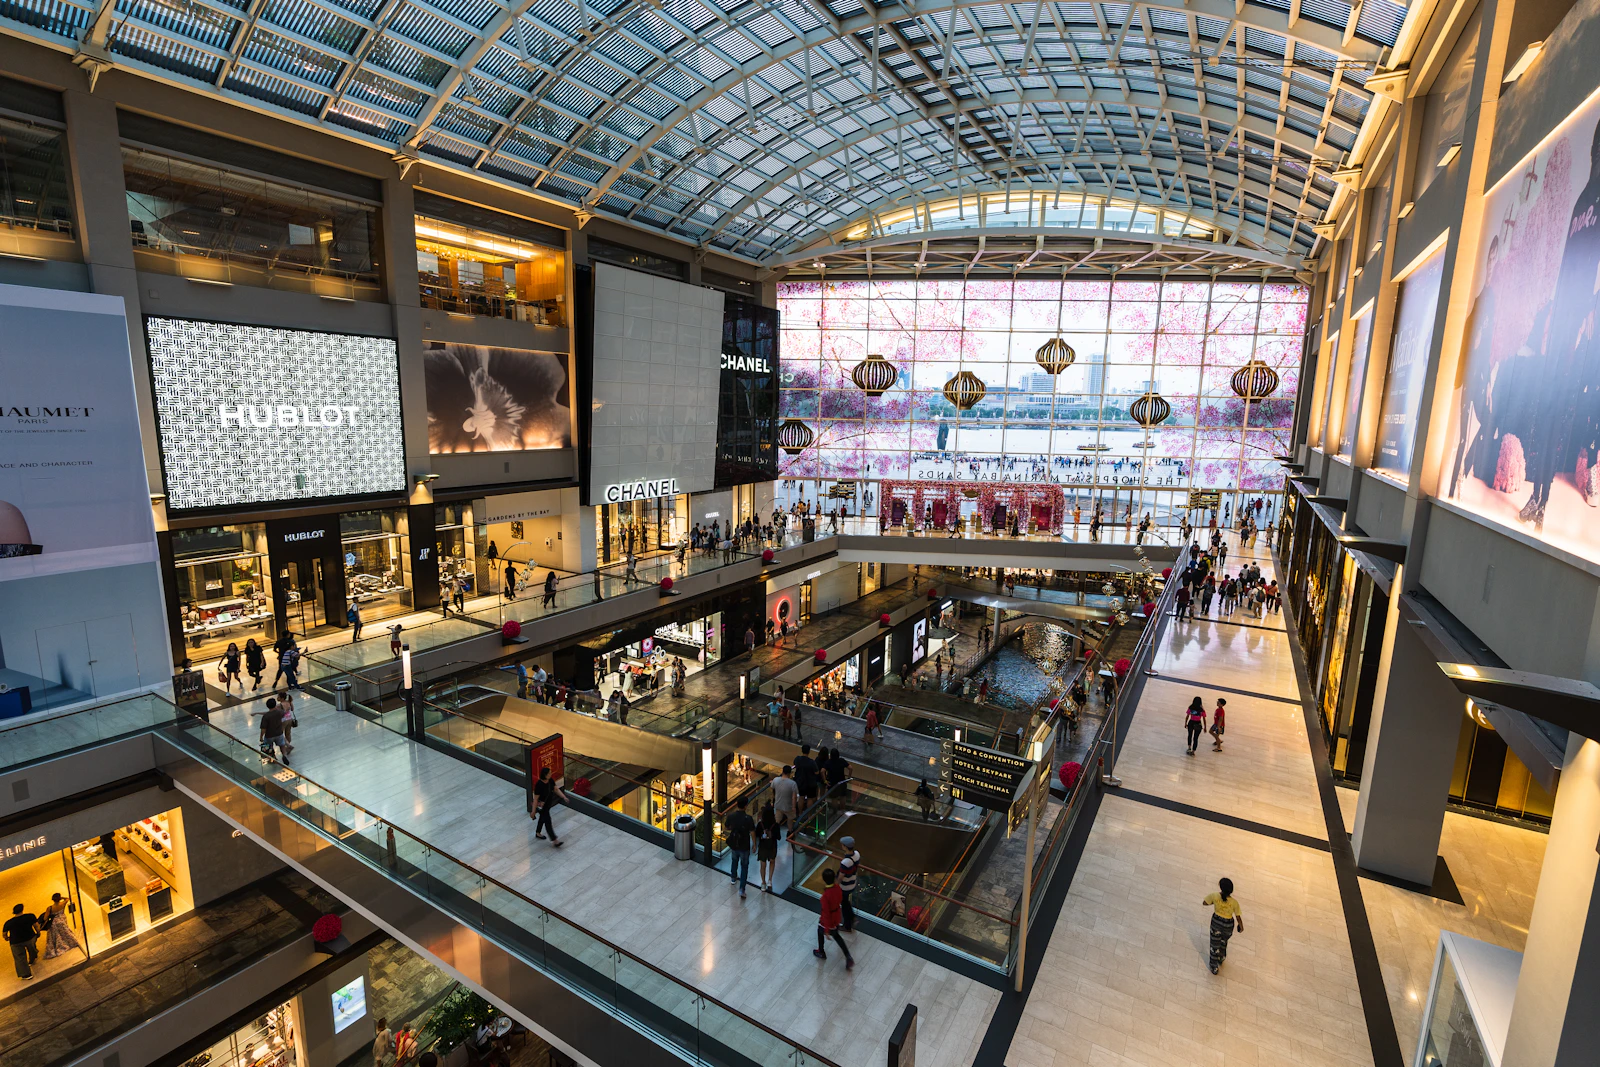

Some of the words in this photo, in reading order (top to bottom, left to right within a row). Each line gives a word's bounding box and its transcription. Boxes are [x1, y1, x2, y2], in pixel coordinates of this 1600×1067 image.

[720, 353, 770, 373] CHANEL
[0, 407, 94, 417] AUMET
[219, 404, 361, 429] HUBLOT
[604, 478, 681, 504] CHANEL
[488, 514, 516, 522] GARDENS
[284, 529, 326, 543] HUBLOT
[654, 621, 679, 635] CHANEL
[954, 744, 972, 755] EXPO
[978, 752, 1025, 767] CONVENTION
[954, 760, 975, 769] HOTEL
[982, 768, 1013, 780] SKYPARK
[953, 774, 975, 784] COACH
[976, 780, 1010, 794] TERMINAL
